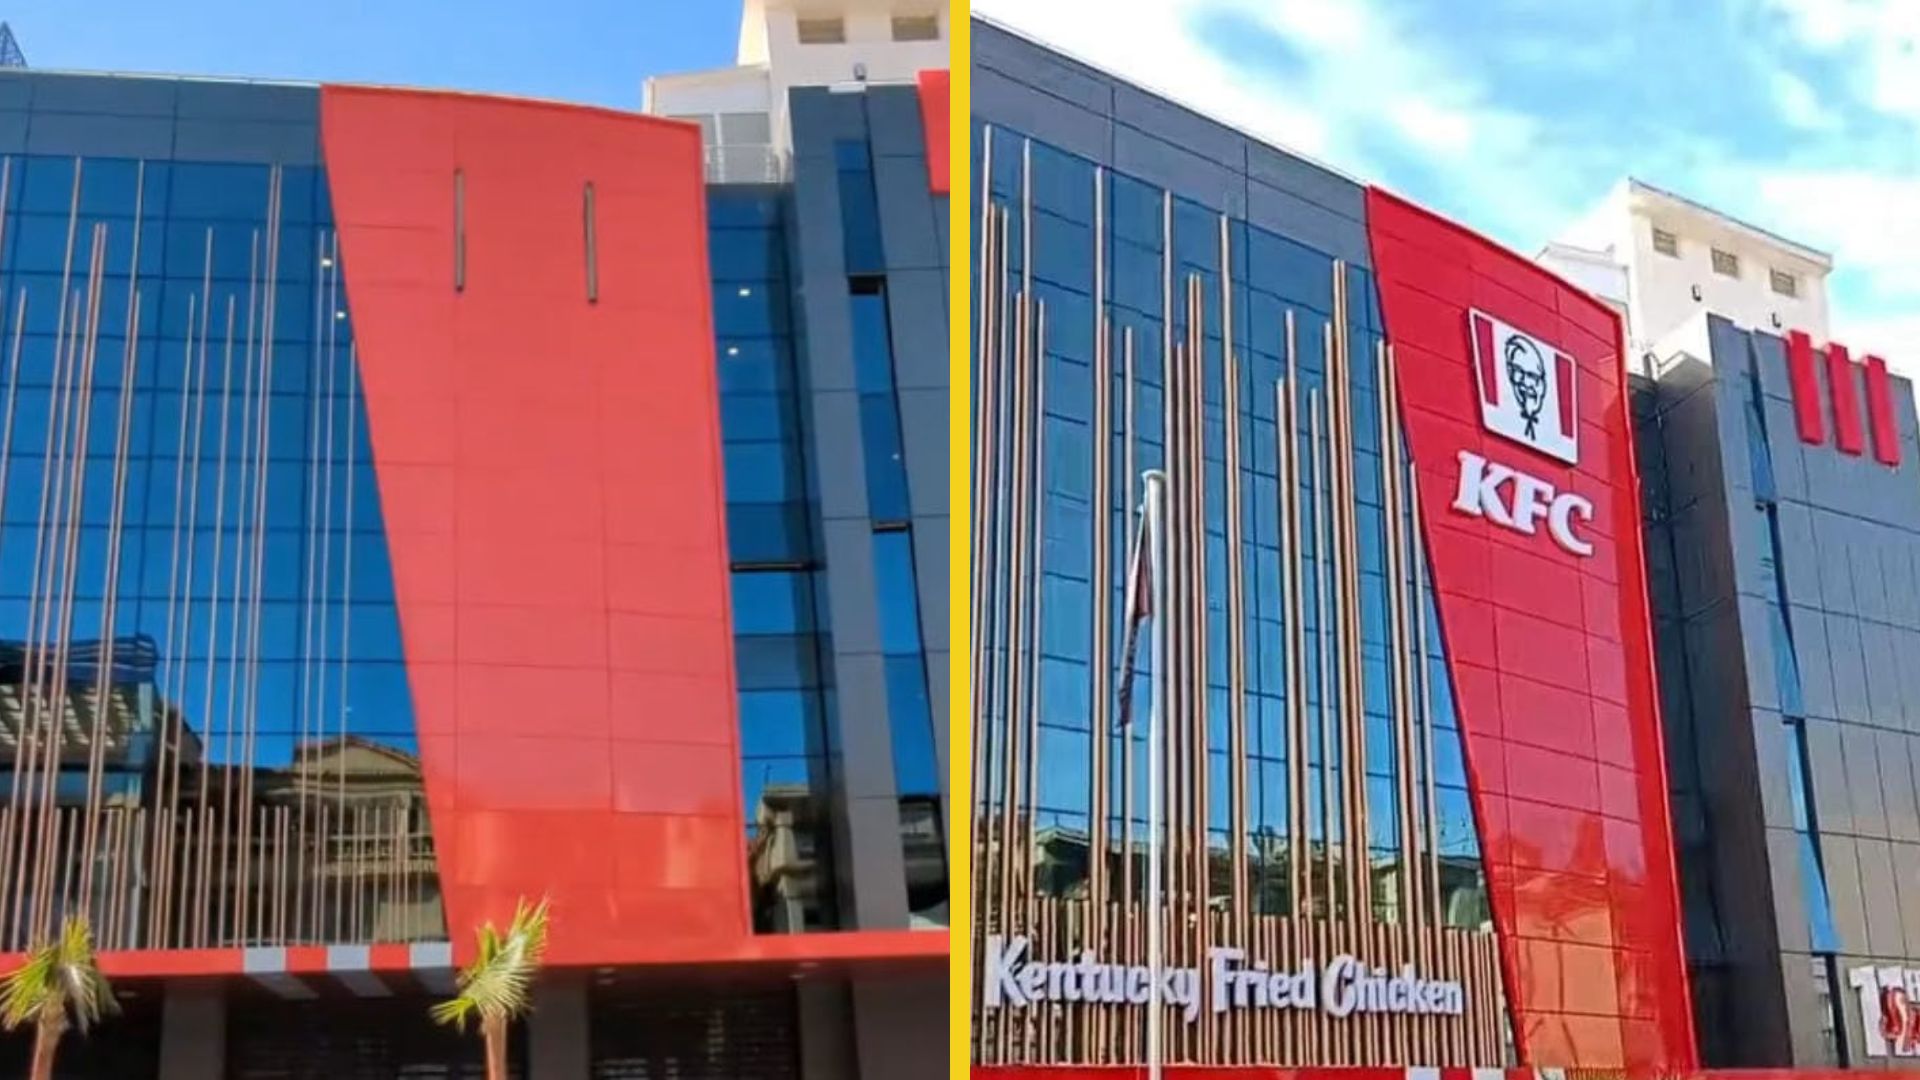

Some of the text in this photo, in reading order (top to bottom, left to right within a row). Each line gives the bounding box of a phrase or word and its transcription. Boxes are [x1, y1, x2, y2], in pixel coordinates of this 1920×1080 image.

[1452, 449, 1594, 556] KFC
[984, 934, 1464, 1023] Kentucky Fried Chicken
